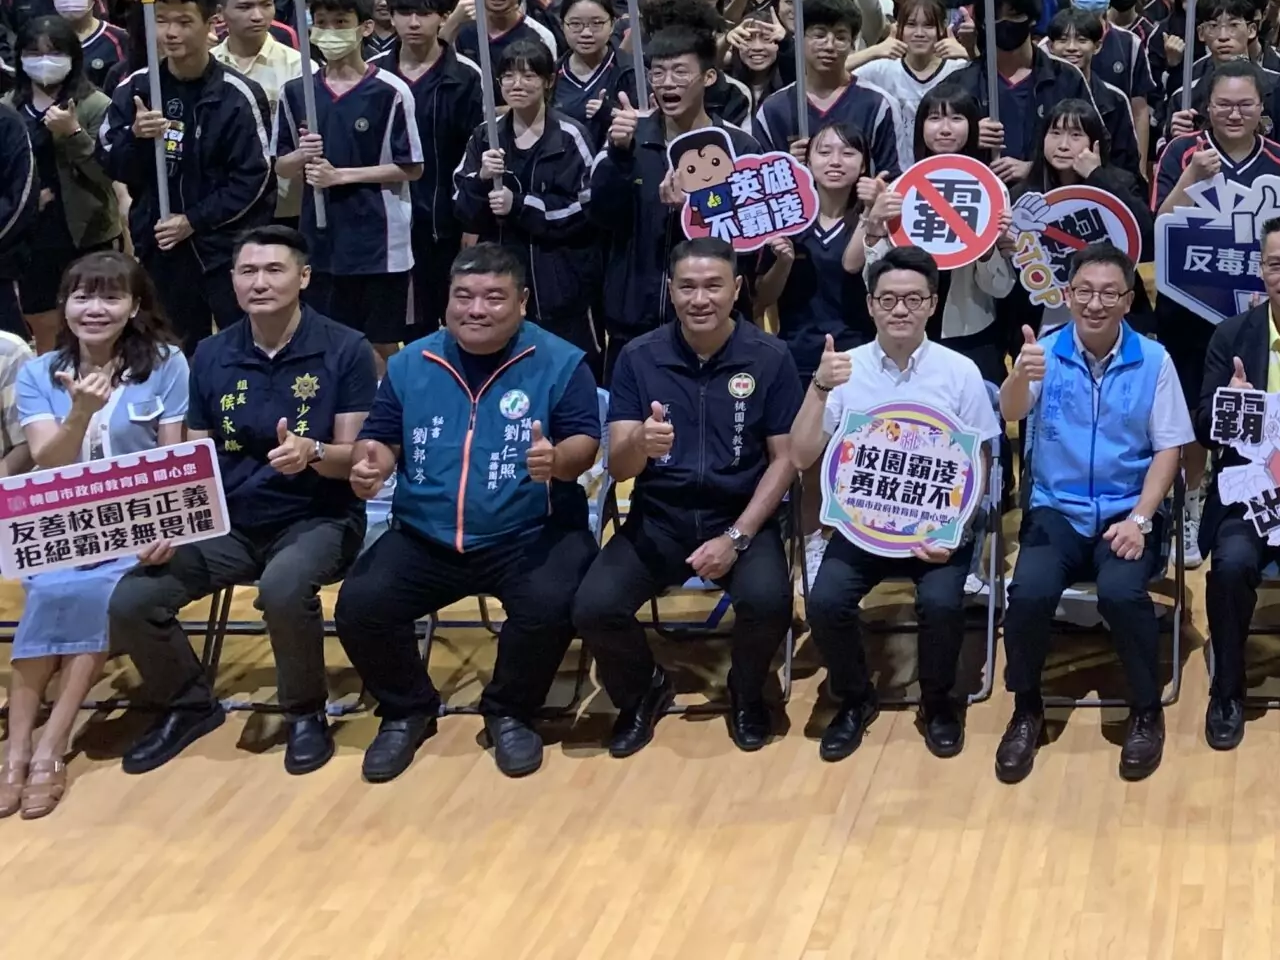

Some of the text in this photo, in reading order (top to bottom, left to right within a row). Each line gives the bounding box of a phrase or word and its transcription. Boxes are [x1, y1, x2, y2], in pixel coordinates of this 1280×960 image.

[727, 157, 796, 203] 英雄
[704, 194, 808, 243] 不霸凌
[1015, 231, 1062, 306] STOP
[498, 424, 519, 480] 劉仁照
[855, 443, 958, 485] 校園霸凌
[29, 462, 197, 507] 桃園市政府教育局 關心您
[846, 497, 918, 519] 桃園市政府教育局
[850, 469, 953, 510] 勇敢說不
[8, 485, 210, 545] 友善校園有正義
[14, 508, 215, 570] 拒絕霸凌無畏懼
